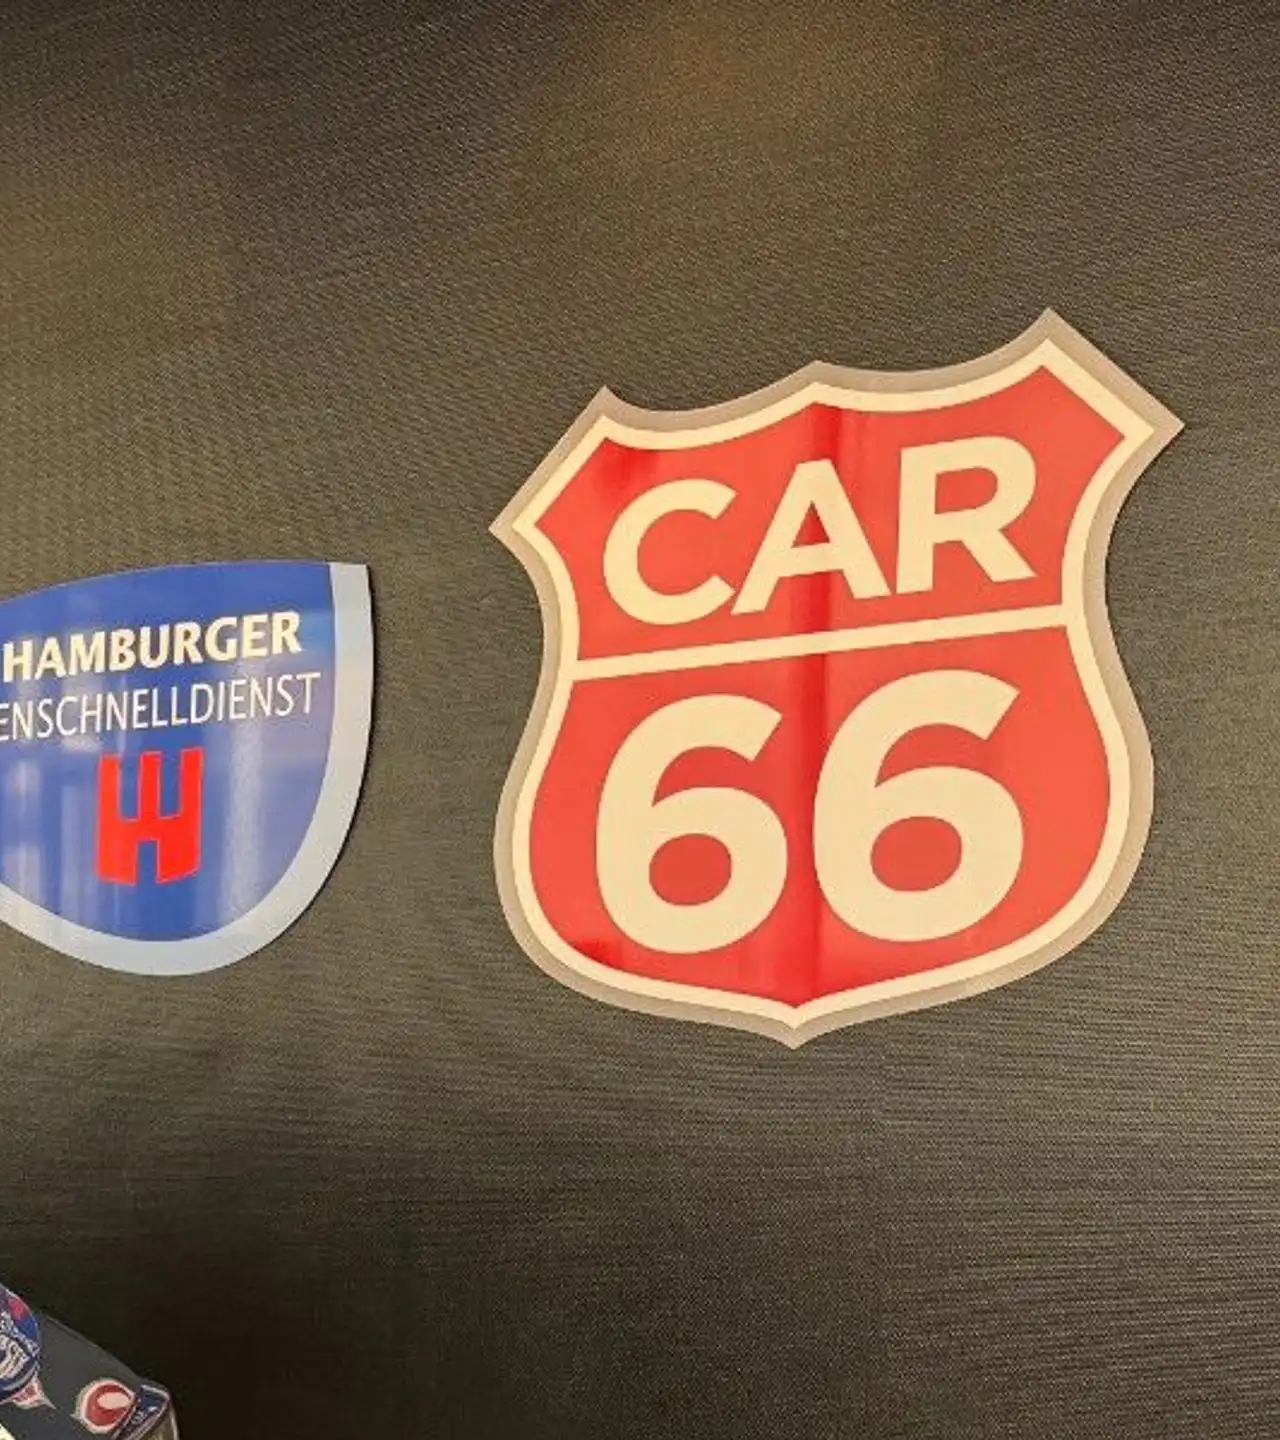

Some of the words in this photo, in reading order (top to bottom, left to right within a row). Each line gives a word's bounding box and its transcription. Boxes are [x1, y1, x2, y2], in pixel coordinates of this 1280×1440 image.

[602, 435, 1037, 626] CAR
[1, 609, 303, 684] HAMBURGER
[594, 668, 1024, 955] 66
